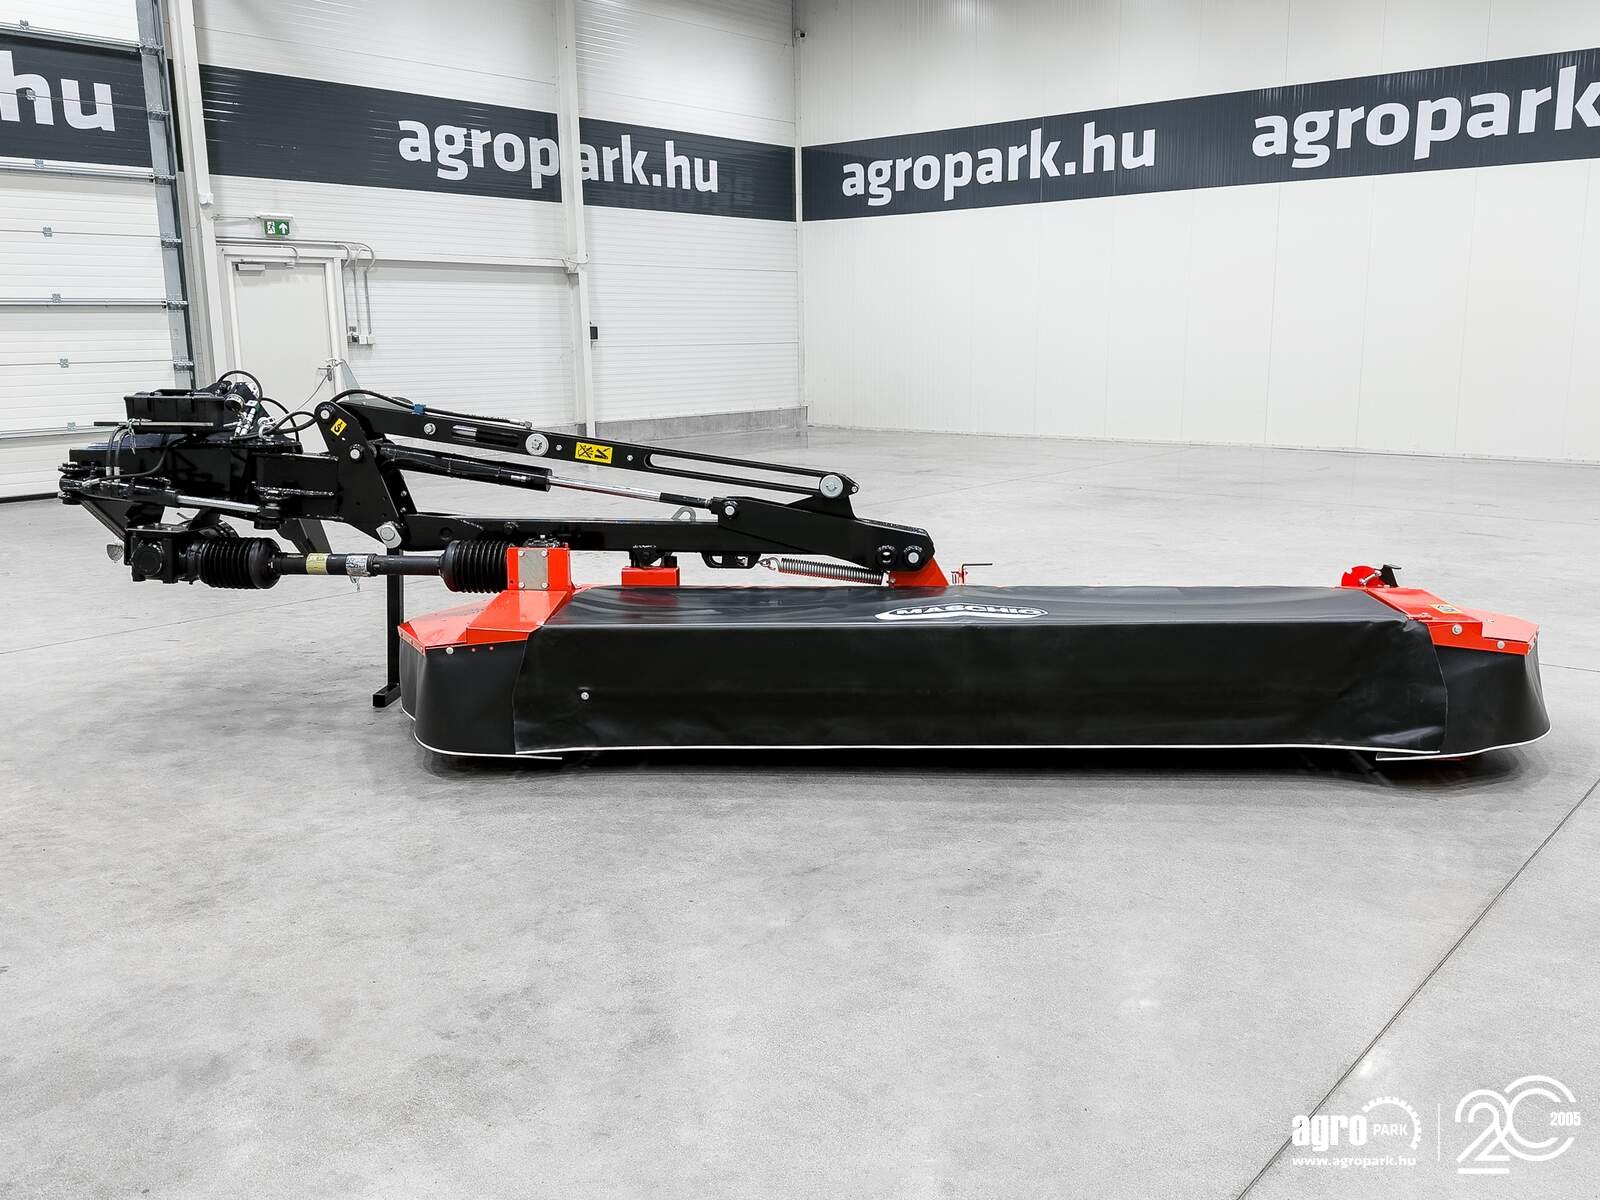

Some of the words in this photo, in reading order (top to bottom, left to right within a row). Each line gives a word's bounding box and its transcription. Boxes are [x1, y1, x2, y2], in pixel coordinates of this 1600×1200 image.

[398, 119, 719, 193] agropark.hu
[1252, 65, 1600, 168] agropark
[841, 121, 1156, 207] agropark.hu
[895, 603, 1042, 616] MASCHIO
